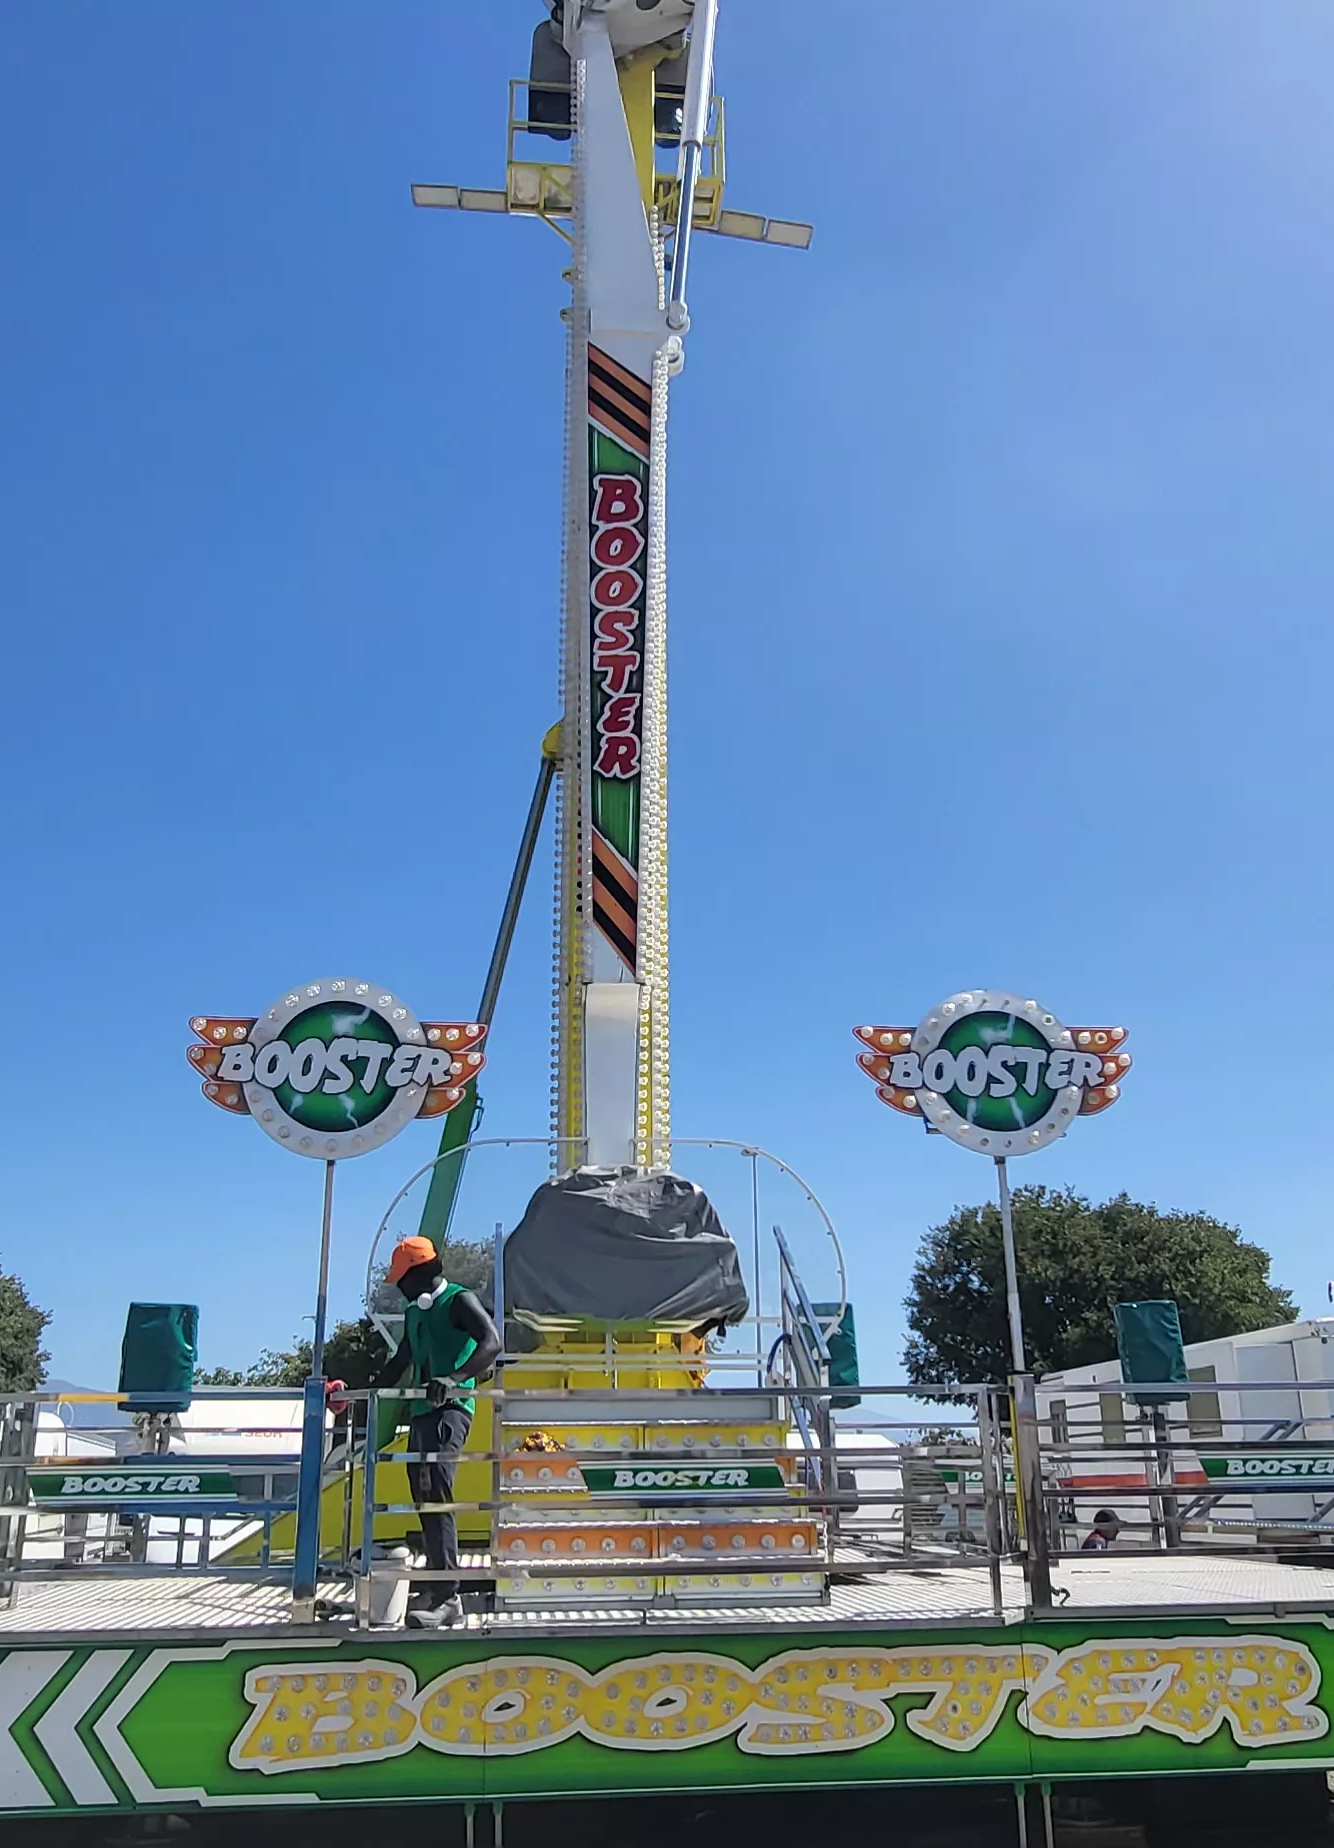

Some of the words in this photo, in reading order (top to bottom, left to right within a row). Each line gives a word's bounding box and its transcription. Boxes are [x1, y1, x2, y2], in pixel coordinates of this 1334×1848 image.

[590, 473, 645, 779] BOOSTER
[217, 1036, 454, 1095] BOOSTER
[889, 1044, 1105, 1098] BOOSTER
[61, 1475, 201, 1493] BOOSTER
[614, 1469, 749, 1487] BOOSTER
[227, 1635, 1331, 1774] BOOSTER
